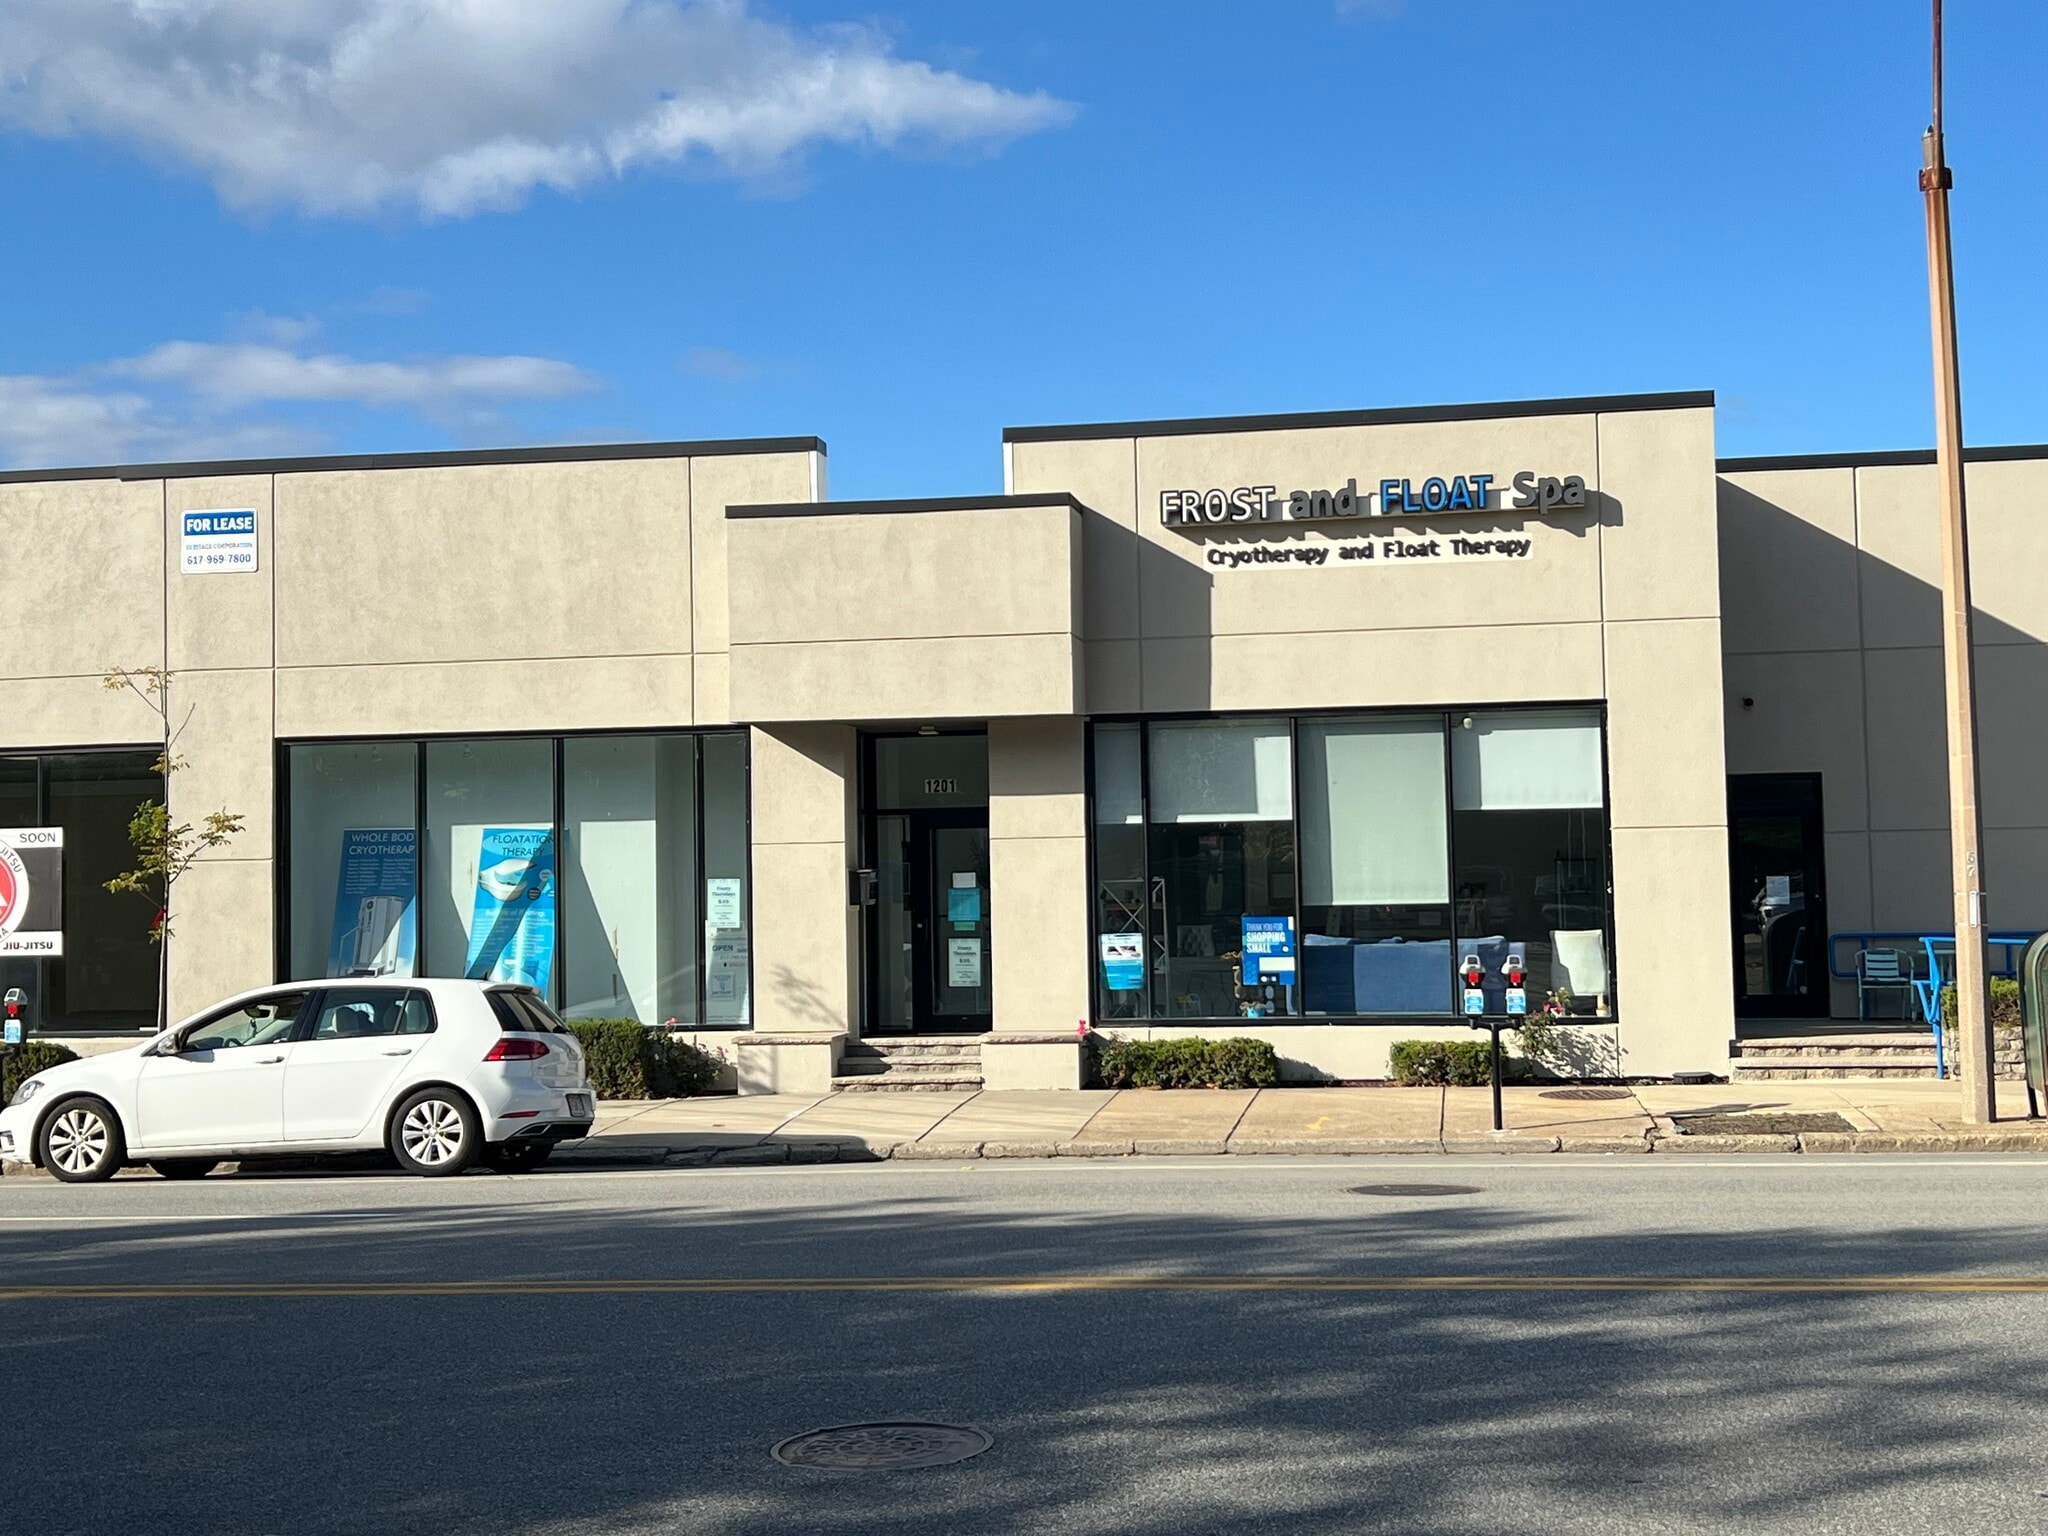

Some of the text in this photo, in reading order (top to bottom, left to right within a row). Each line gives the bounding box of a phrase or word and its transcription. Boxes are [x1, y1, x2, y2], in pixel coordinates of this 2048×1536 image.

[1160, 471, 1585, 524] FROST and FLOAT Spa
[186, 517, 252, 531] FOR LEASE
[1206, 538, 1532, 568] Cryotherapy and Float Therapy
[926, 779, 955, 793] 1201
[19, 832, 56, 843] SOON
[351, 832, 415, 842] WHOLE BOD
[349, 845, 416, 855] CRYOTHERAP
[502, 847, 545, 856] THERAPY
[1246, 932, 1286, 942] SHOPPING
[2, 941, 53, 950] JIU-JITSU
[1246, 943, 1272, 953] SMALL
